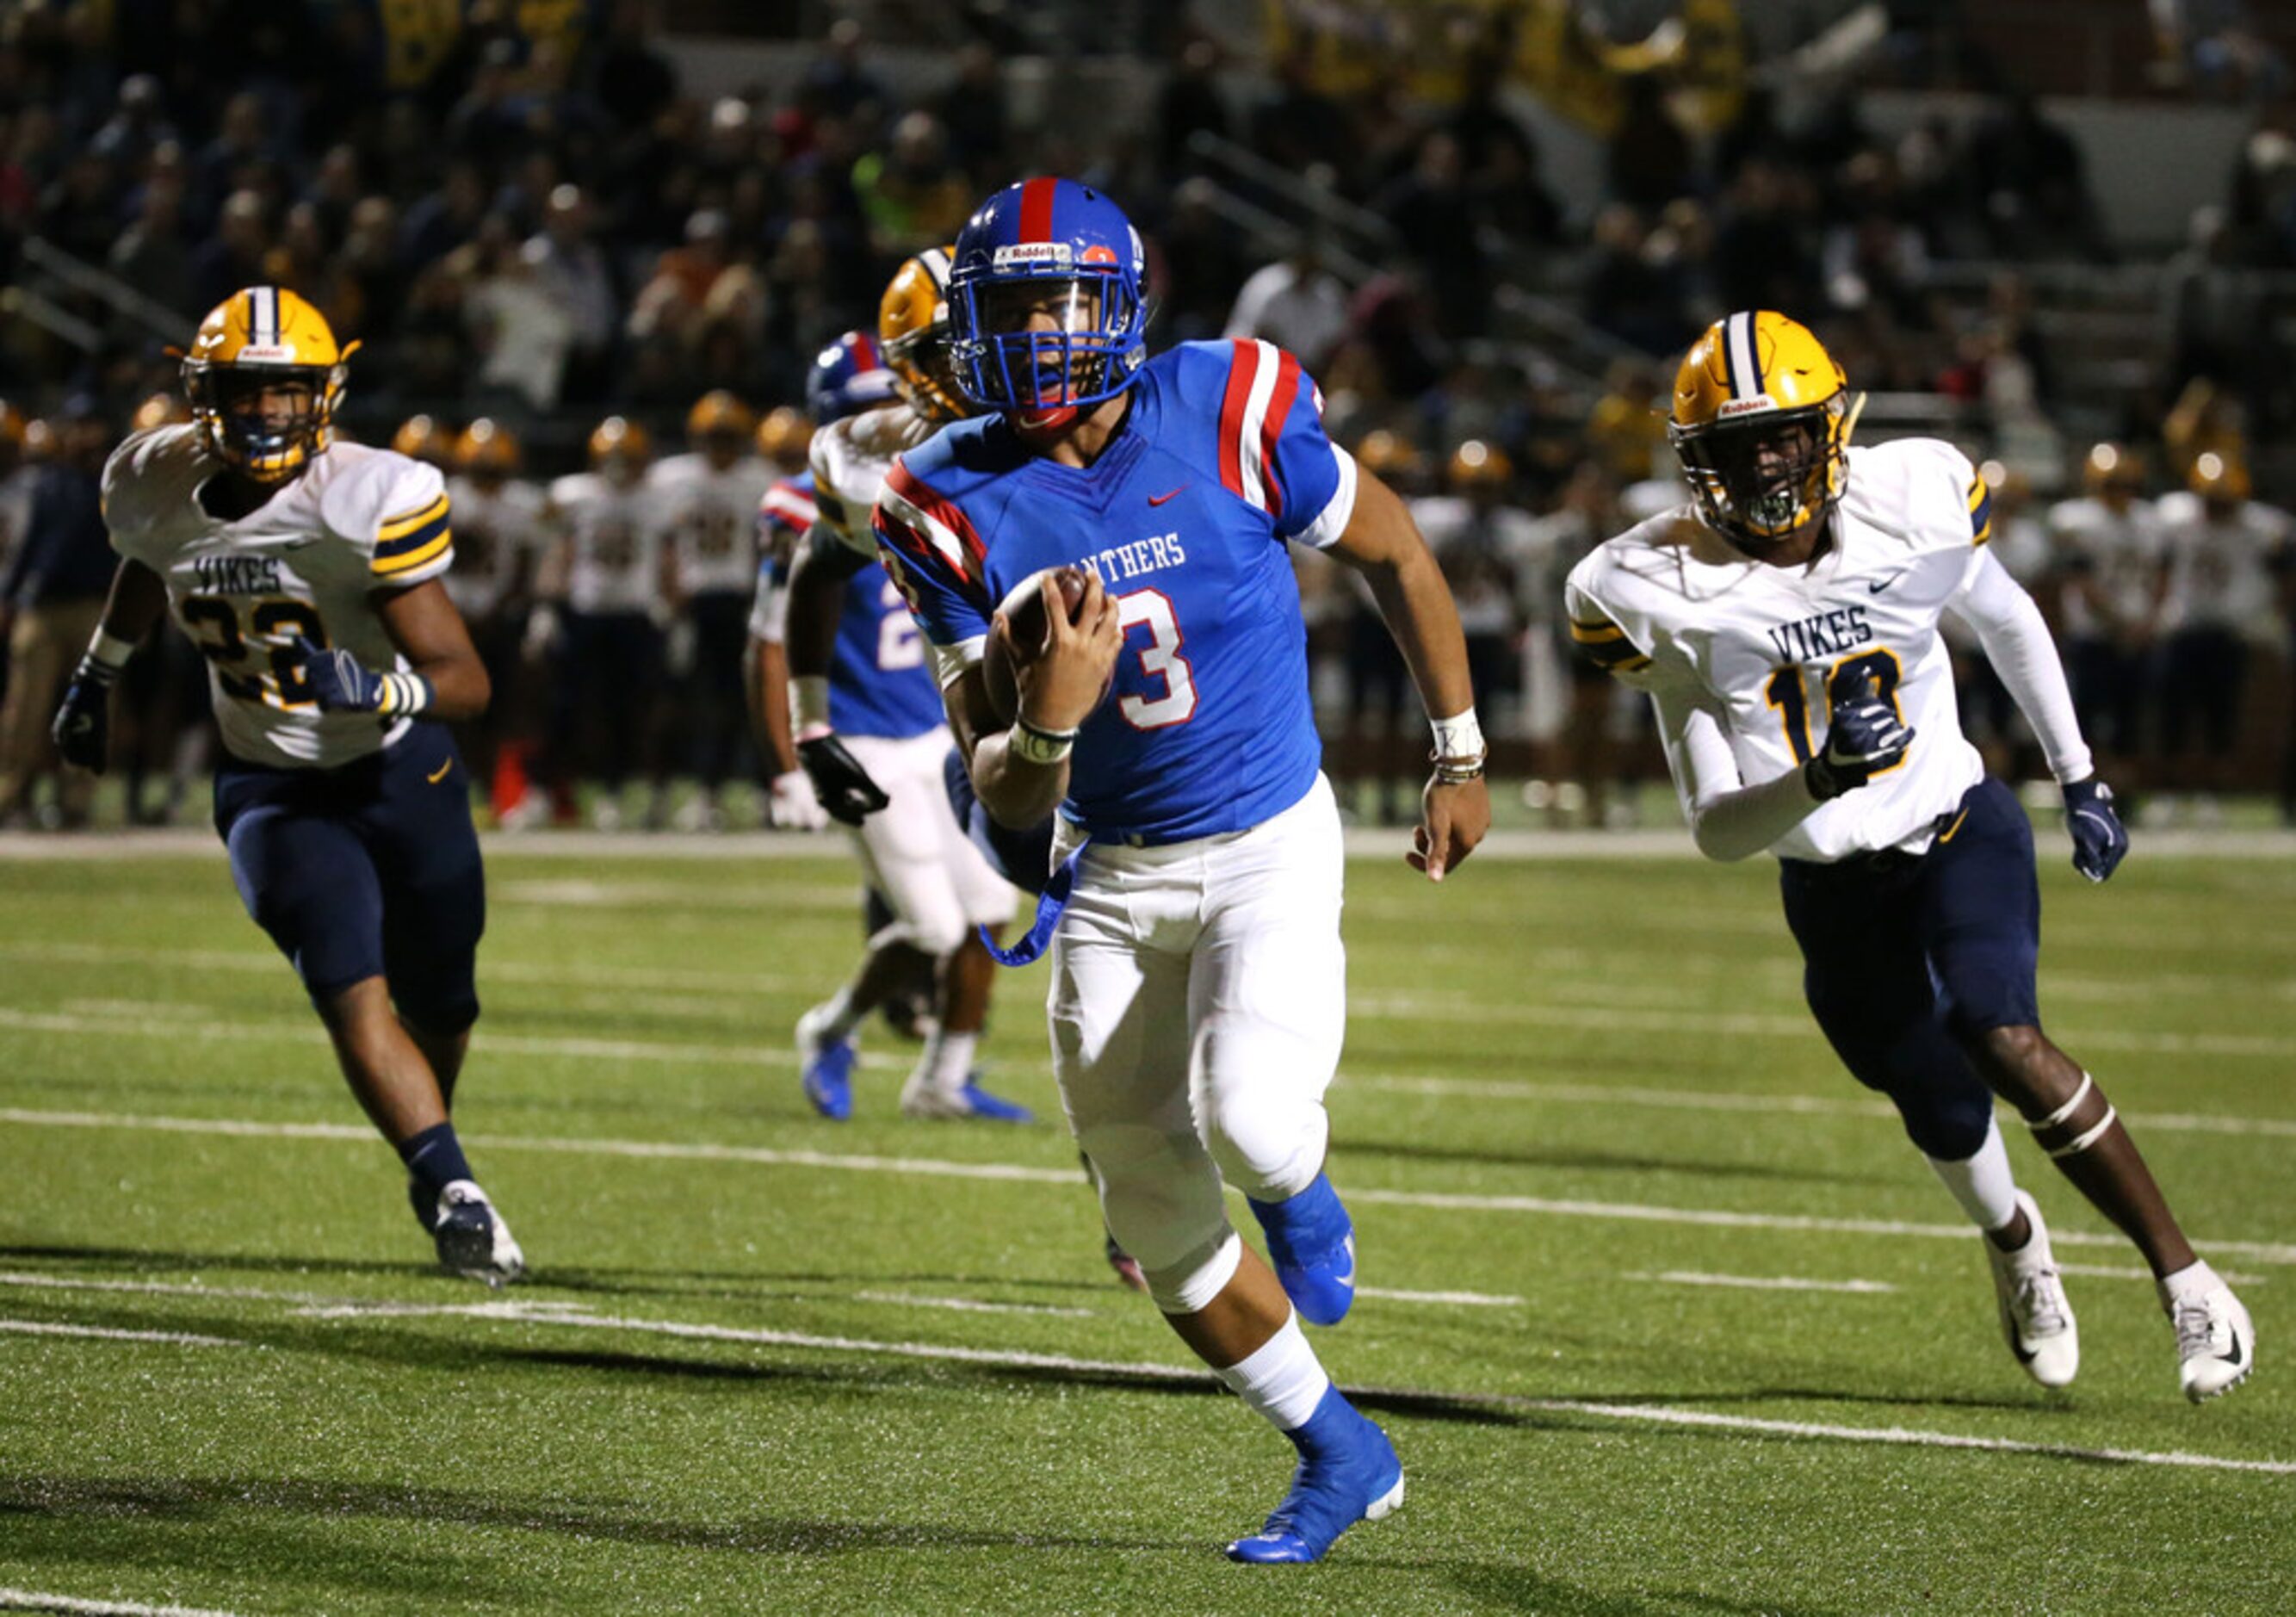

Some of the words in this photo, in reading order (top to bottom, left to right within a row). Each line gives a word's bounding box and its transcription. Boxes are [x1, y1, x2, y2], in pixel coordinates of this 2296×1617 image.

[195, 557, 282, 594] VIKES
[1070, 532, 1186, 586] NTHERS
[1117, 585, 1199, 731] 3
[1767, 605, 1873, 662] VIKES
